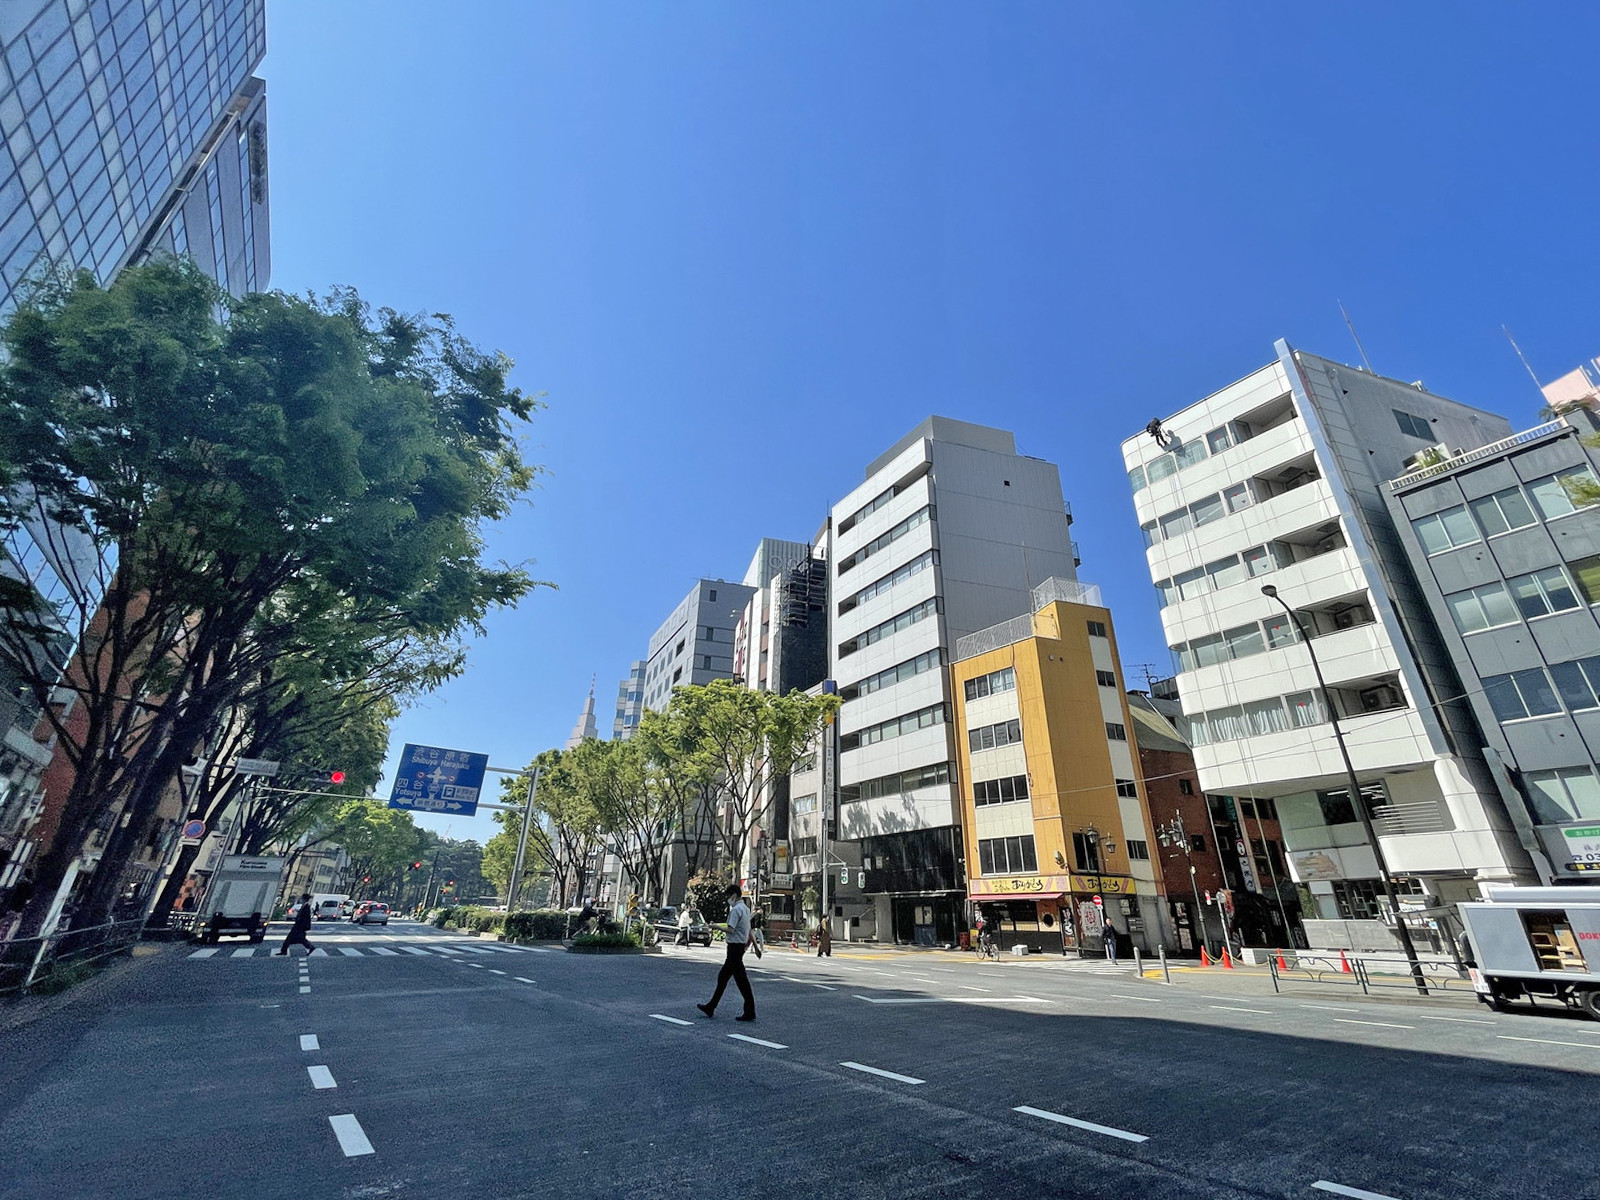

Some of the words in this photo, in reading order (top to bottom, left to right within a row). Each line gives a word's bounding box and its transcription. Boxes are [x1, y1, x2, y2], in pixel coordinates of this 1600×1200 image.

[414, 746, 440, 759] 渋谷
[445, 750, 470, 763] 原宿
[411, 756, 438, 766] Shibuya
[440, 760, 470, 770] Harajuku
[397, 777, 424, 790] 四谷
[395, 787, 422, 799] Yotsuya
